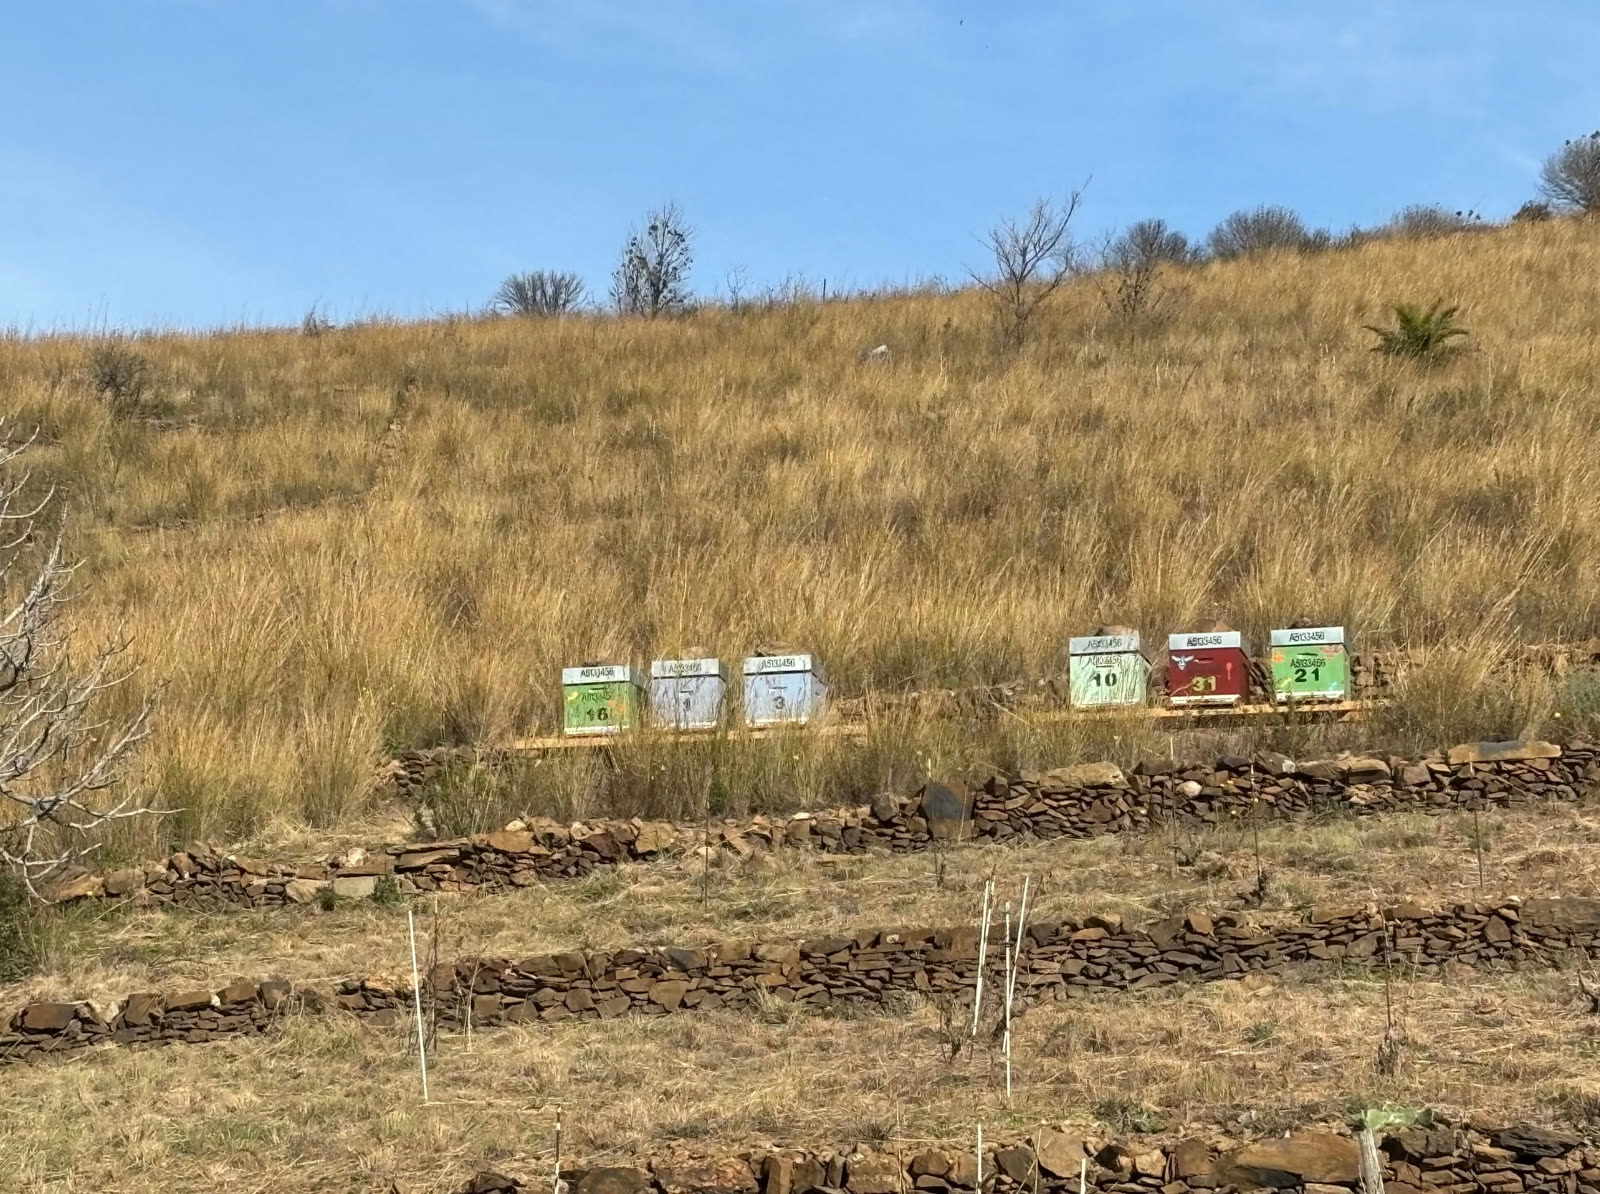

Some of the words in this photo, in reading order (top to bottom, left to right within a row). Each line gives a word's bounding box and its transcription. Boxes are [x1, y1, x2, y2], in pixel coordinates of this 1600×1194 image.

[1092, 673, 1117, 687] 10
[1294, 667, 1320, 683] 21
[1192, 675, 1216, 692] 31
[772, 696, 785, 709] 3
[587, 706, 608, 721] 16
